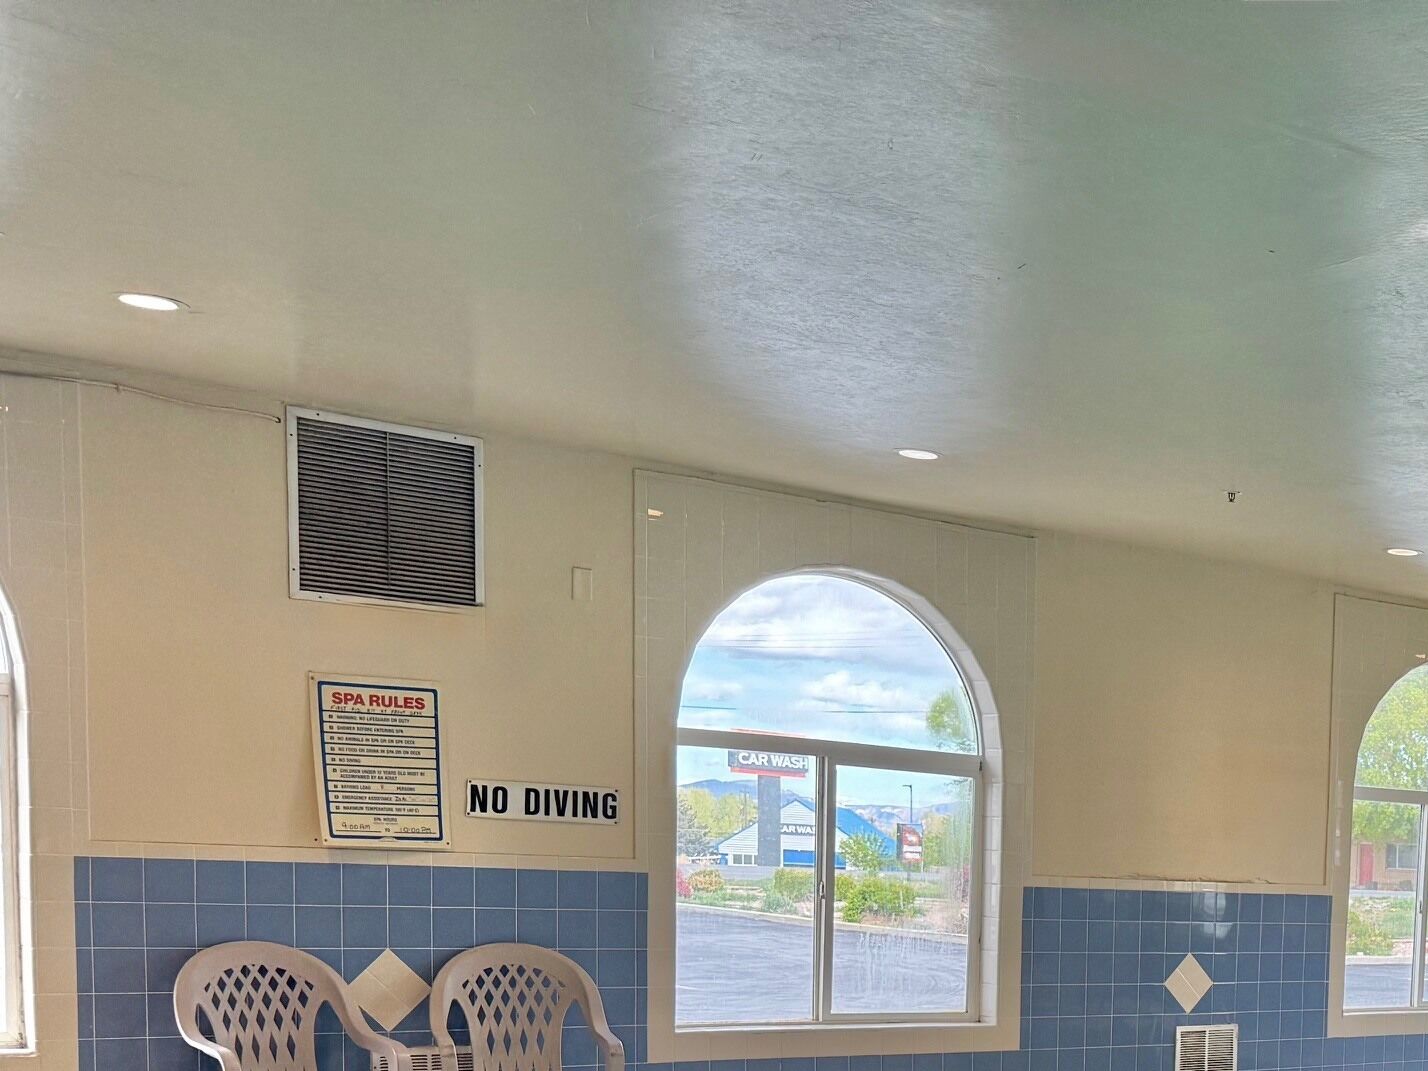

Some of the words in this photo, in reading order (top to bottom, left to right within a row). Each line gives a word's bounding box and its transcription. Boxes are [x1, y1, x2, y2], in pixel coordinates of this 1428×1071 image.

[332, 692, 365, 706] SPA
[369, 694, 425, 710] RULES
[738, 752, 768, 766] CAR
[770, 754, 808, 770] WASH
[470, 784, 508, 814] NO
[524, 788, 617, 820] DIVING
